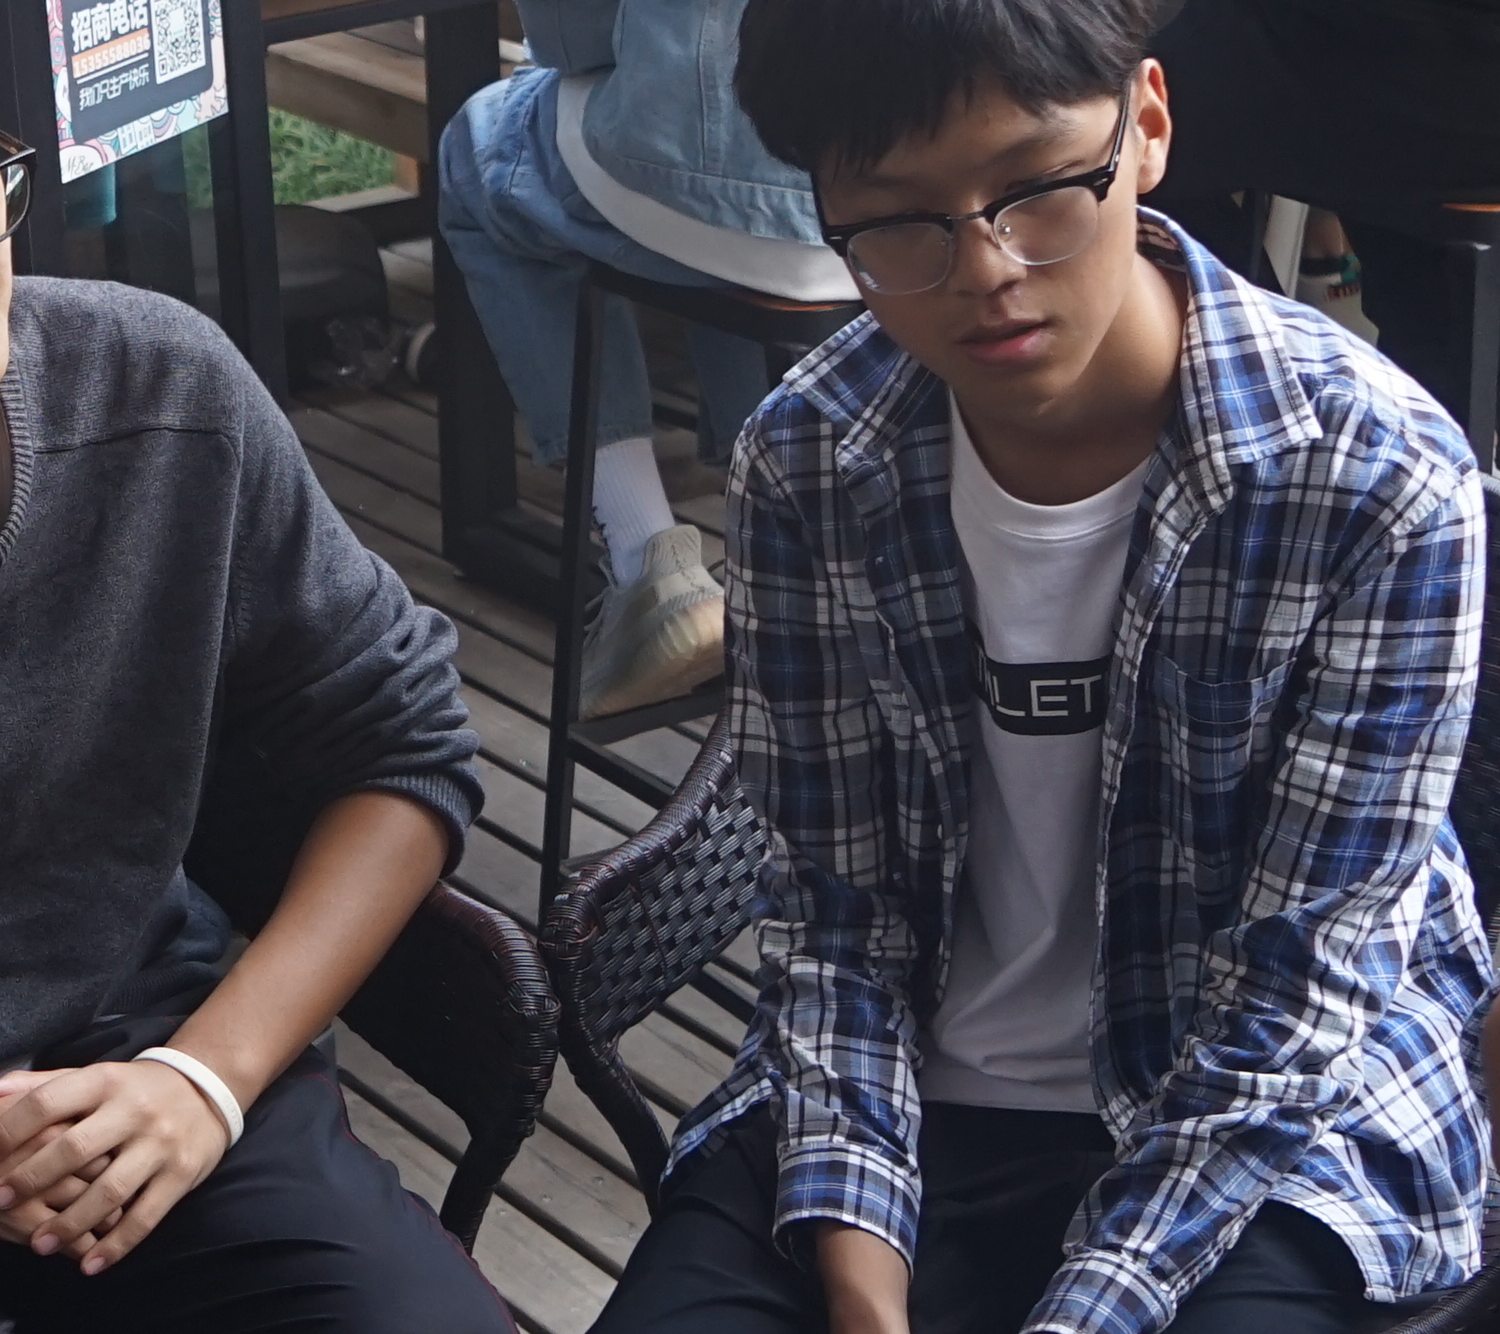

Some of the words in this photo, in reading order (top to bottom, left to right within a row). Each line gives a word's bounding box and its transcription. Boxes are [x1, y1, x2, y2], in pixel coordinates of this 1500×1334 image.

[73, 32, 151, 78] 15355588036
[78, 63, 150, 112] 我们只生产快乐
